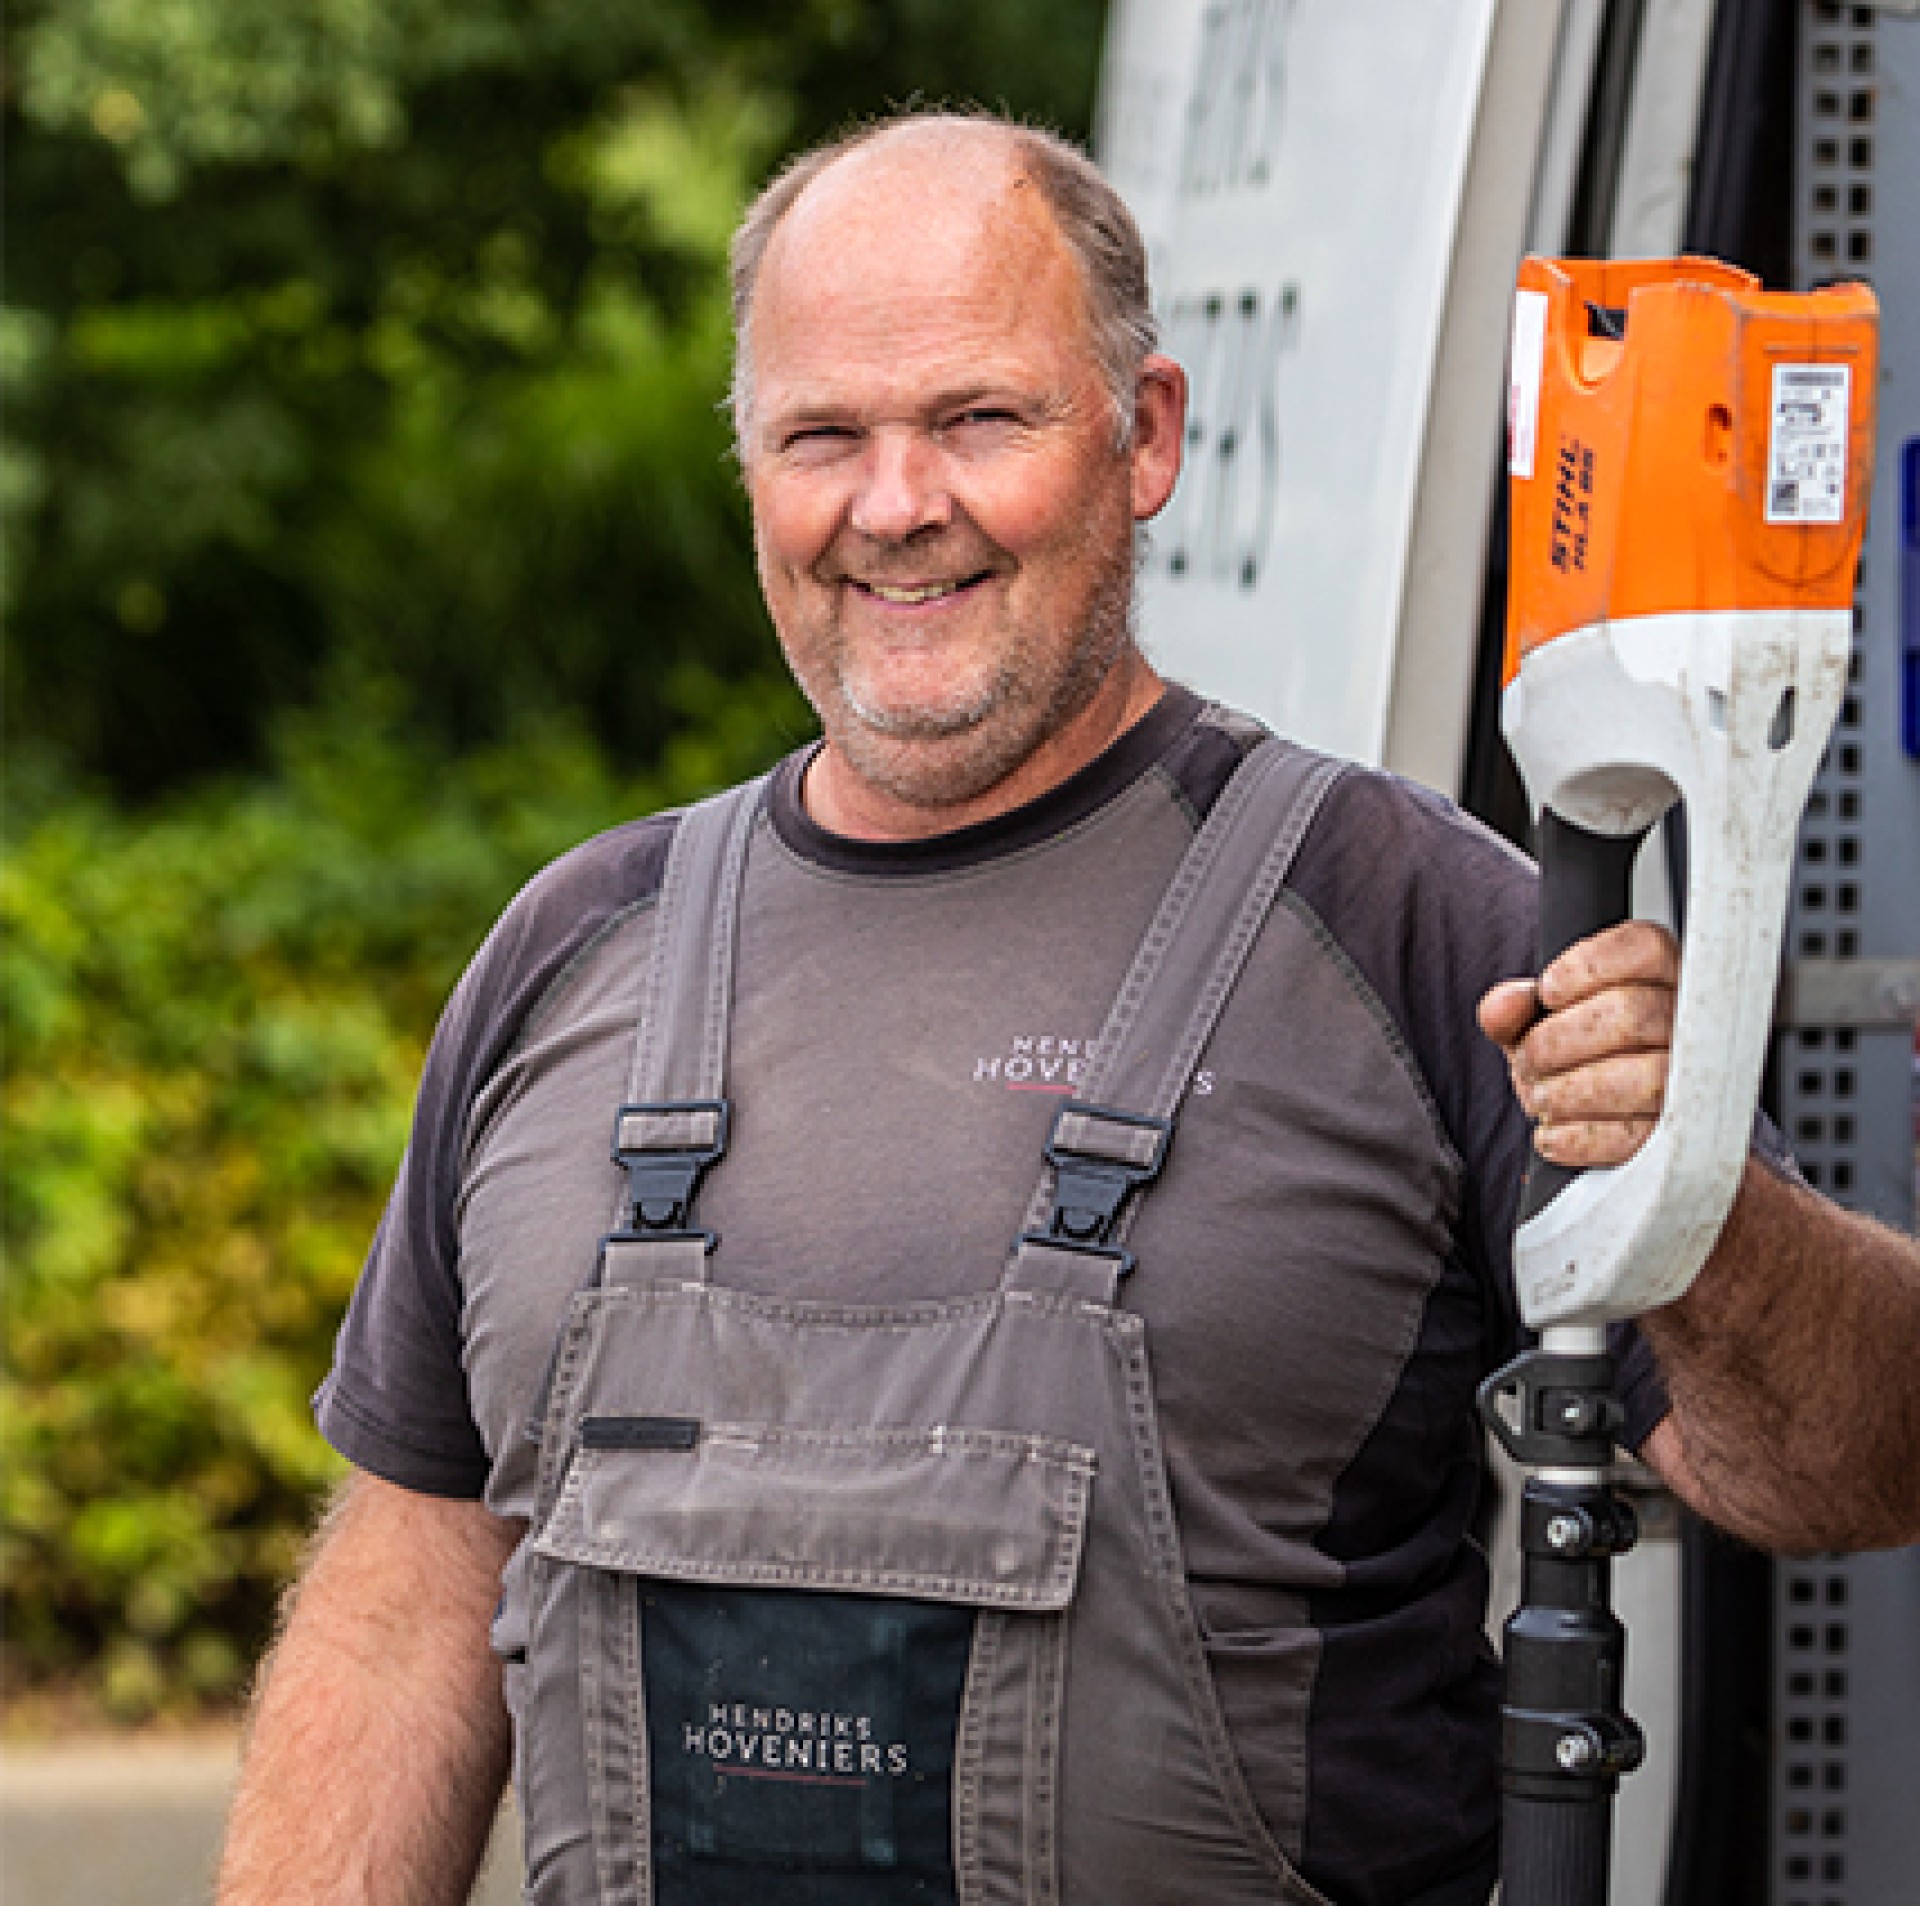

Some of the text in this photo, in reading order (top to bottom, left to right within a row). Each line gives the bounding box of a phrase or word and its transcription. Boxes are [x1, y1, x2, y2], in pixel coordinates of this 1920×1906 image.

[1551, 440, 1578, 573] STIHL
[972, 1057, 1216, 1095] HOVES
[682, 1724, 907, 1772] HOVENIERS
